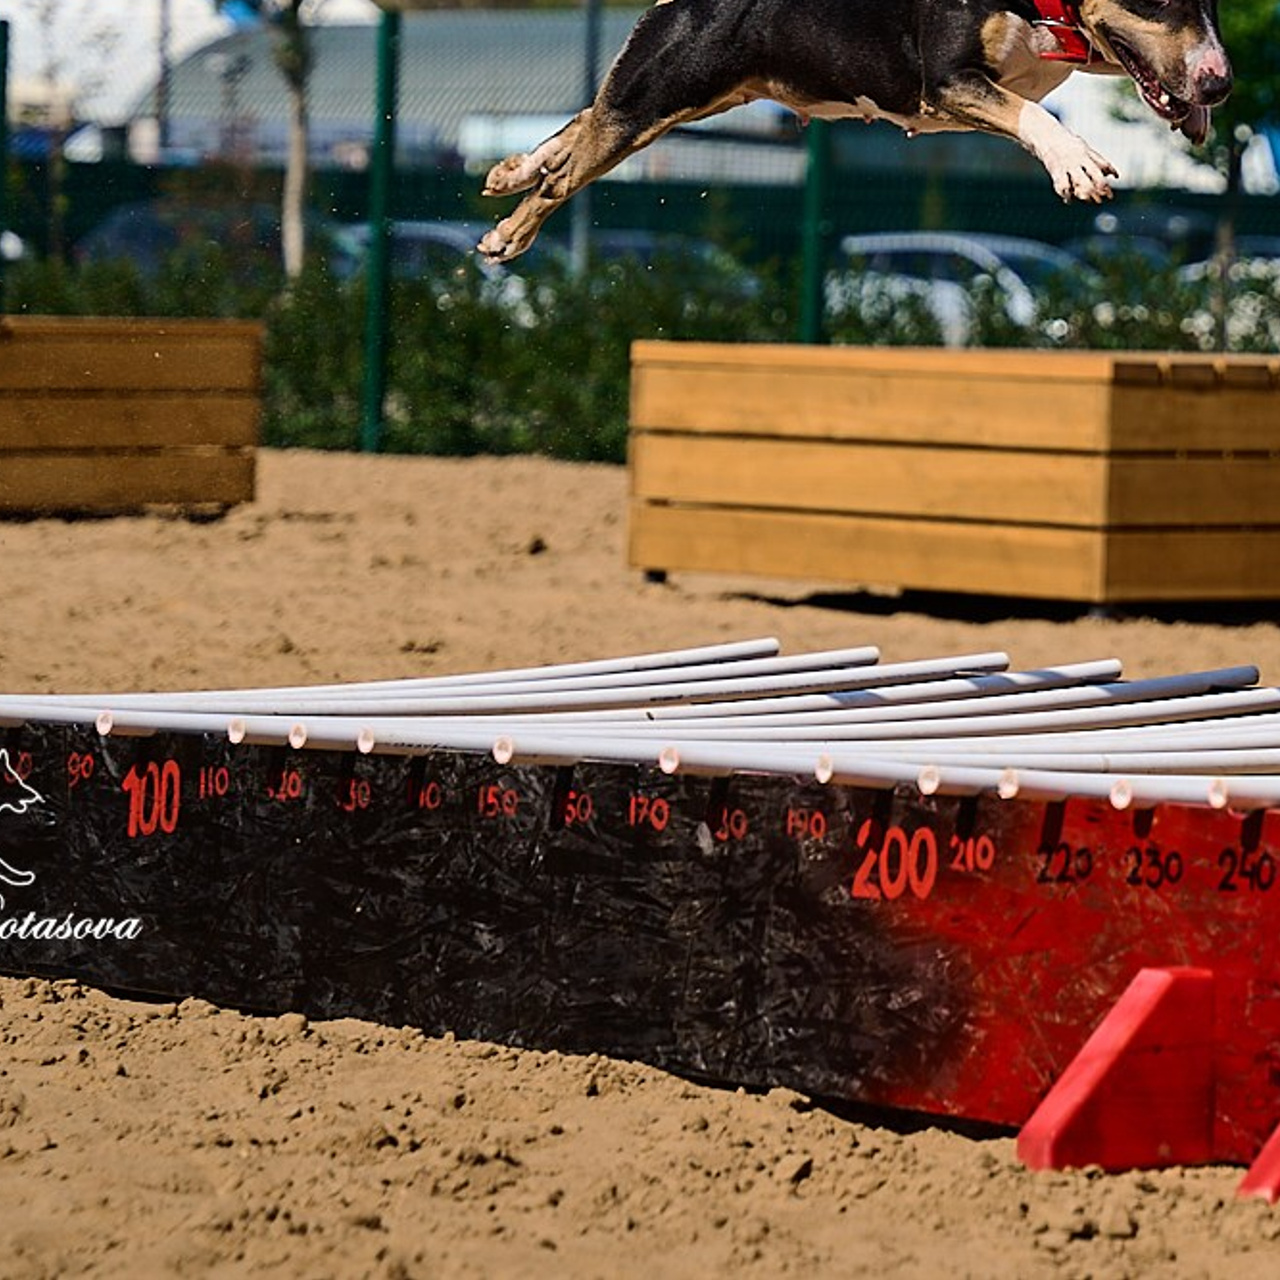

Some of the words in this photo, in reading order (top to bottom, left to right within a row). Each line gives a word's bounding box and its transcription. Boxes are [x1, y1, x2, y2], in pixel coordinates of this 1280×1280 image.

[67, 751, 94, 787] 90
[199, 766, 229, 799] 110
[121, 759, 181, 838] 100
[477, 784, 520, 821] 150
[628, 795, 670, 832] 170
[786, 808, 827, 839] 190
[851, 818, 938, 901] 200
[949, 833, 995, 873] 210
[1036, 841, 1094, 884] 220
[1125, 846, 1184, 889] 230
[1217, 847, 1277, 892] 240
